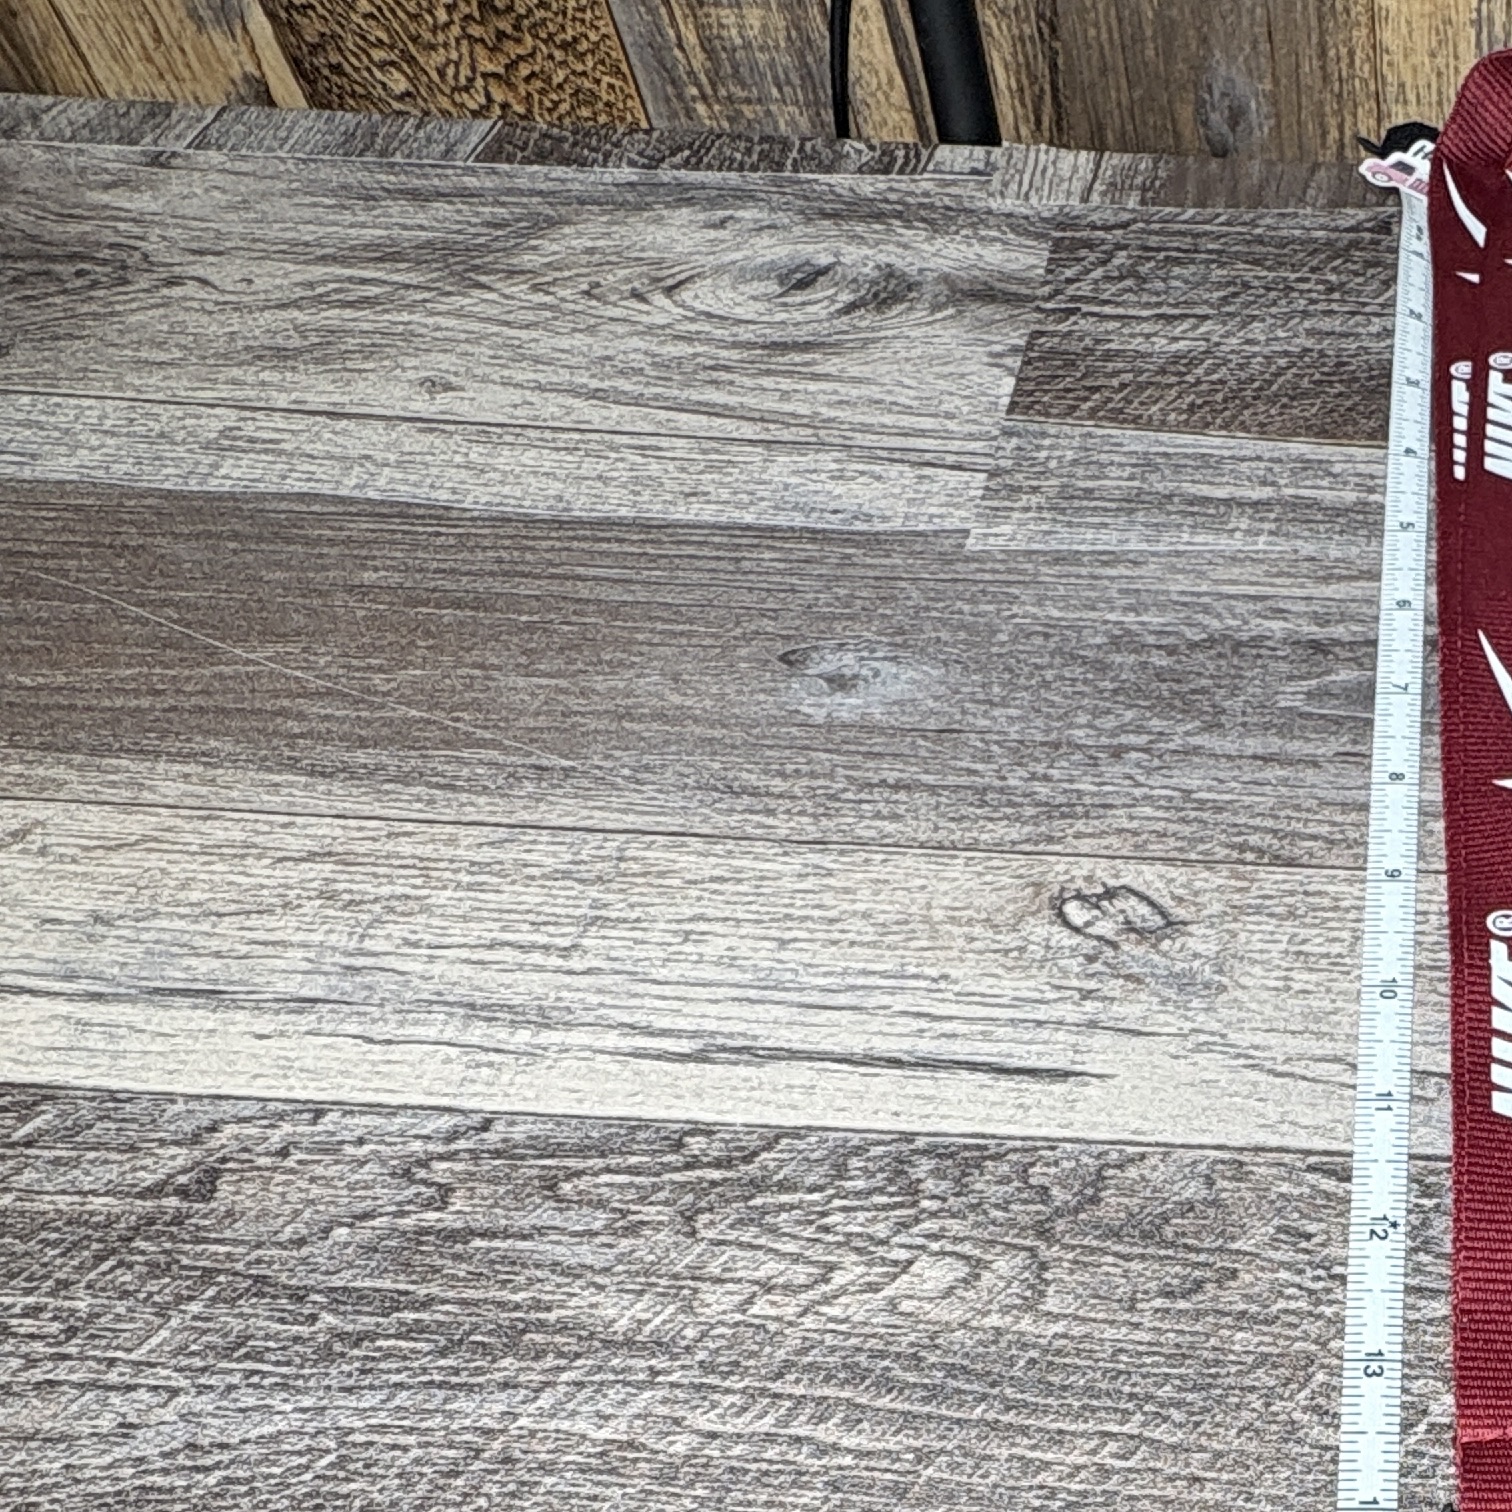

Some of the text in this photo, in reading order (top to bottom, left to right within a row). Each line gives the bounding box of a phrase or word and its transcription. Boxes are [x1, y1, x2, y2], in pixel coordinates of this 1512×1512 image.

[1405, 376, 1421, 387] 3
[1403, 446, 1418, 456] 4
[1399, 521, 1416, 530] 5
[1395, 600, 1412, 609] 6
[1391, 682, 1410, 692] 7
[1388, 772, 1406, 782] 8
[1384, 868, 1402, 879] 9
[1379, 976, 1398, 1000] 10
[1374, 1090, 1394, 1112] 11
[1368, 1214, 1390, 1242] 12
[1363, 1349, 1385, 1379] 13
